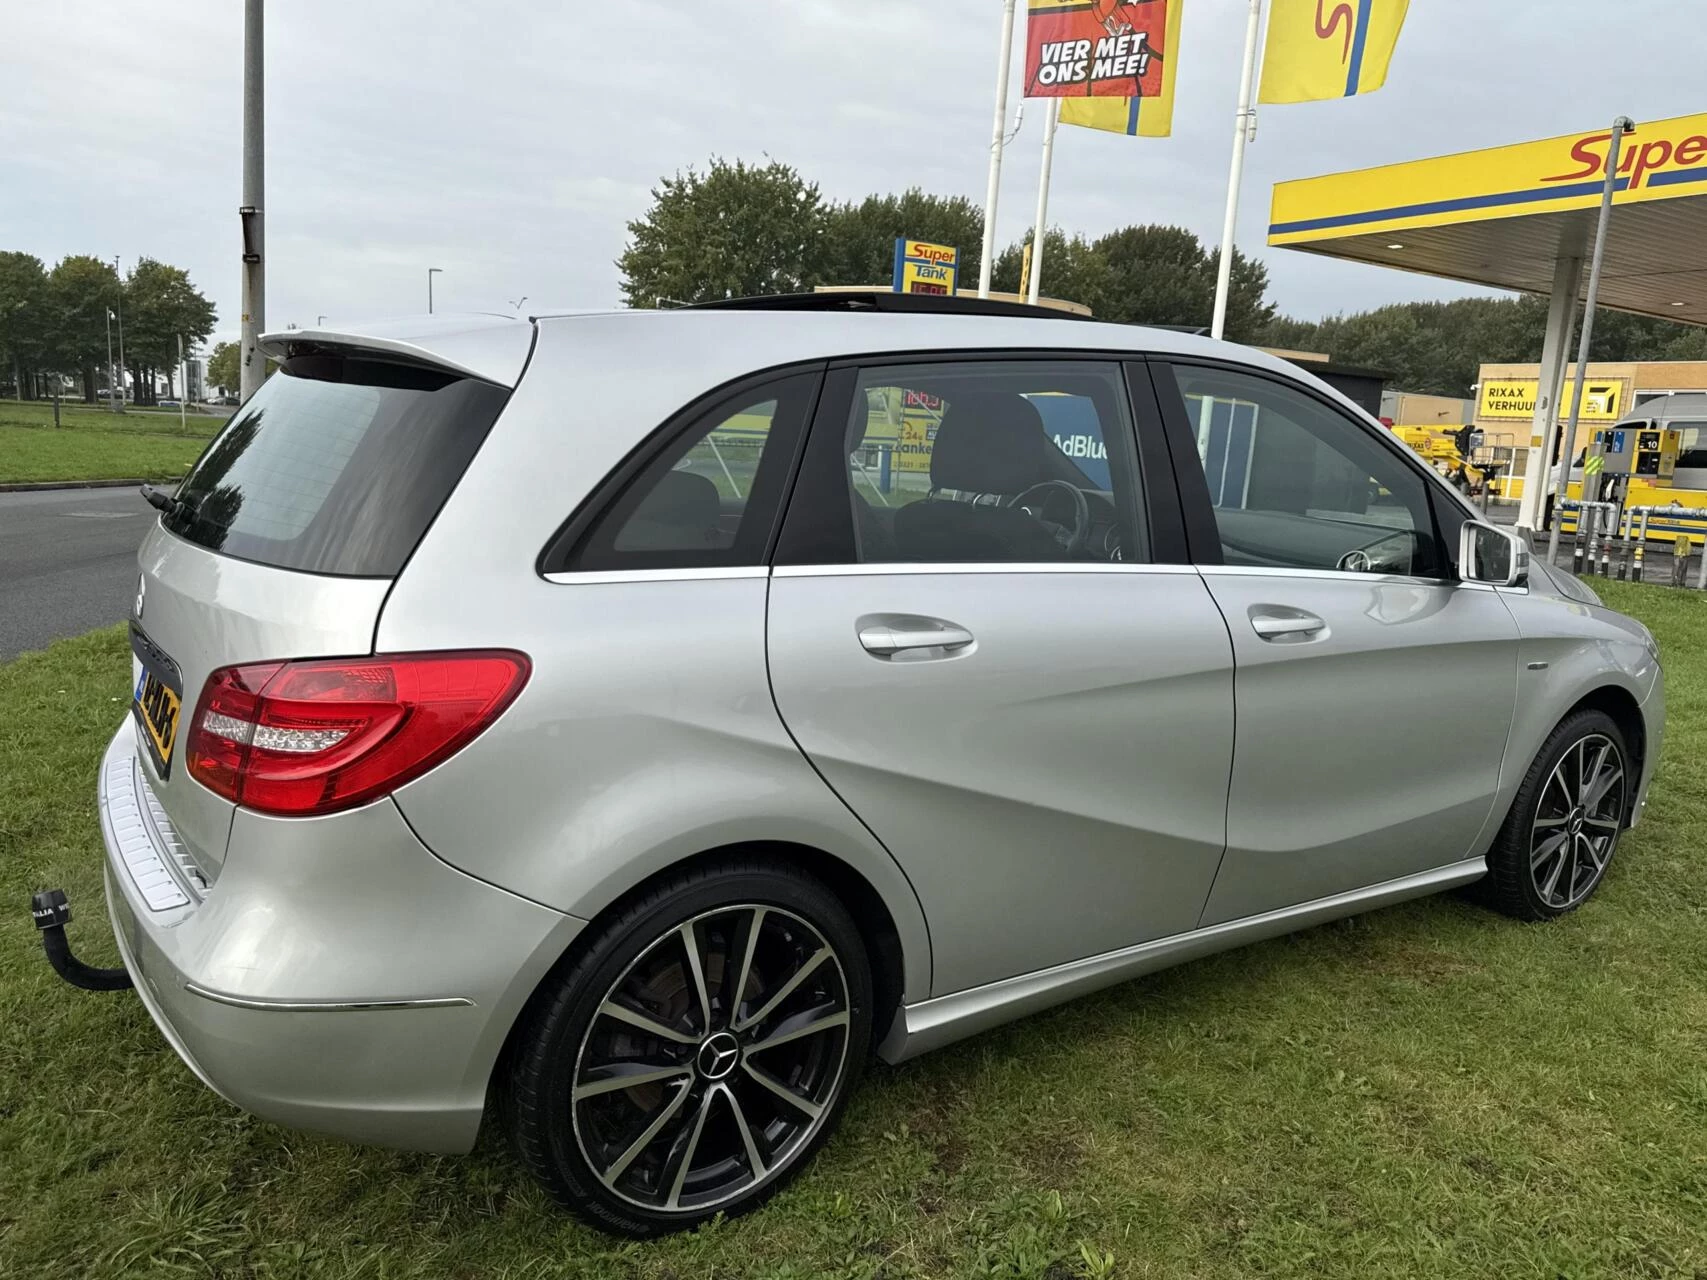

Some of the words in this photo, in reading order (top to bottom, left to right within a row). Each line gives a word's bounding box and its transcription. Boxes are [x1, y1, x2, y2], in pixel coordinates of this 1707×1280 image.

[1041, 39, 1091, 64] VIER
[1095, 33, 1147, 58] MET
[1038, 60, 1088, 84] ONS
[1091, 54, 1149, 79] MEE!
[906, 243, 955, 265] Super
[913, 264, 946, 280] Tank
[1488, 388, 1524, 397] RIXAX
[1647, 440, 1658, 449] 10
